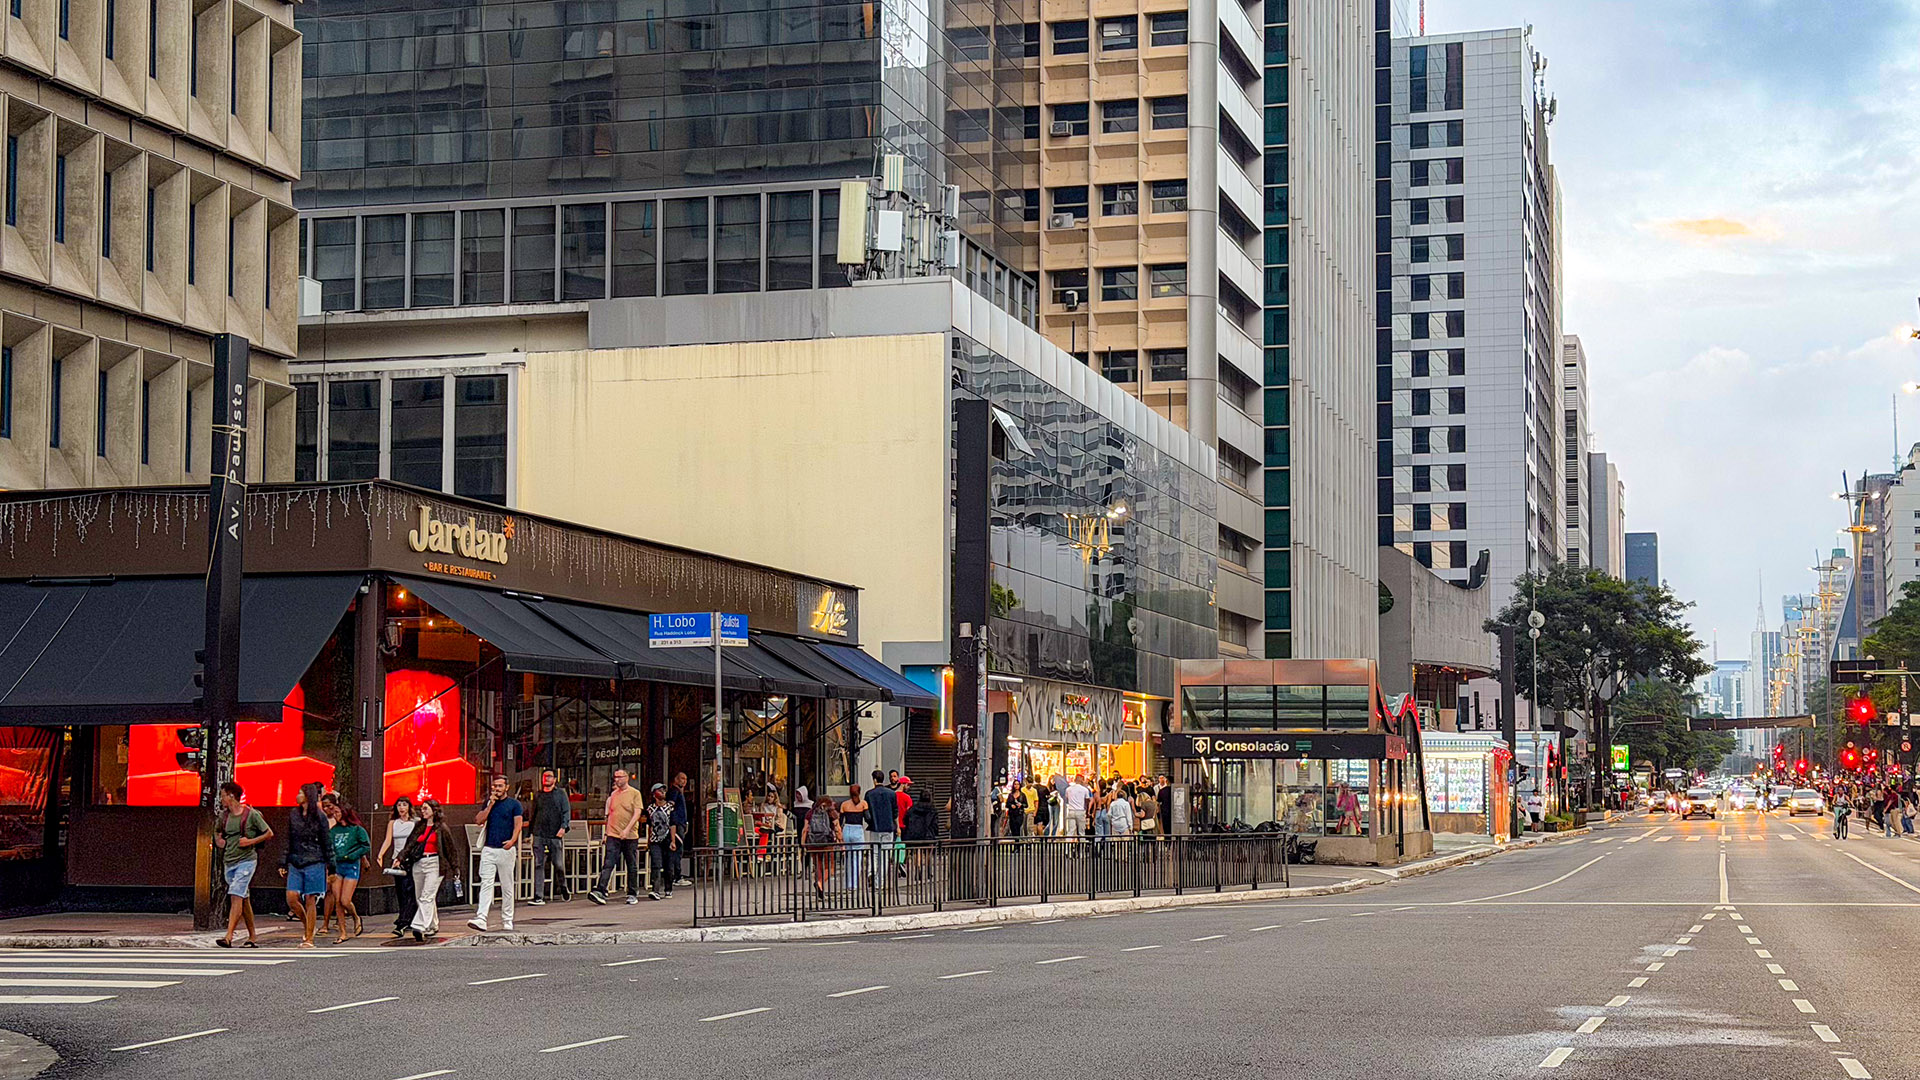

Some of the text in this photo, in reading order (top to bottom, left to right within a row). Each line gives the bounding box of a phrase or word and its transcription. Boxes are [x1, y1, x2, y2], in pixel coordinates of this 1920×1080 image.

[228, 383, 243, 541] Av. Paulista
[408, 505, 509, 565] Jardan
[428, 561, 492, 581] BAR E RESTAURANTE
[653, 615, 696, 628] H. Lobo
[720, 614, 740, 628] Paulista
[1214, 740, 1290, 753] Consolação
